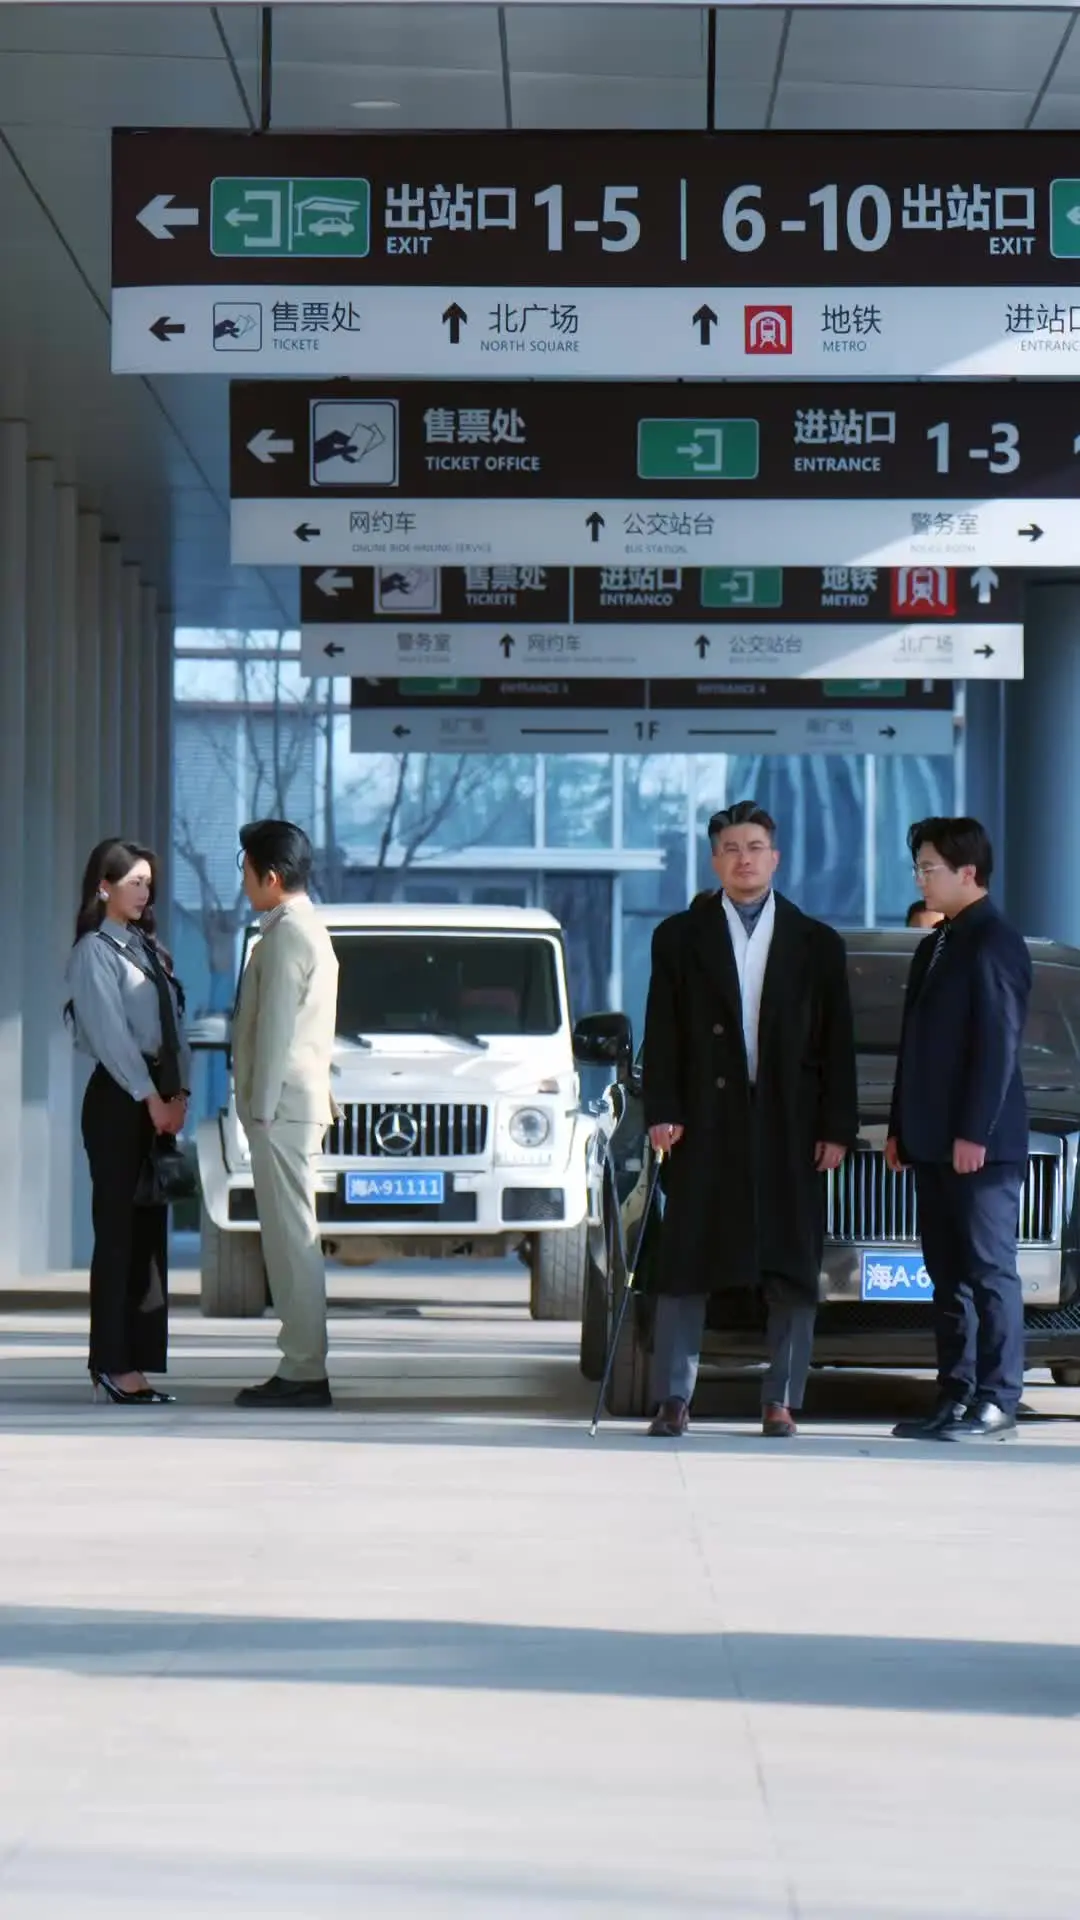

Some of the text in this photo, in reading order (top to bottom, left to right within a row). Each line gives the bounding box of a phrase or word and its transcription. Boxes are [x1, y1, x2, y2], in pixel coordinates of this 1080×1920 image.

[385, 183, 641, 253] 出站口 1-5
[722, 183, 1035, 253] 6-10 出站口
[386, 236, 433, 254] EXIT
[989, 236, 1035, 255] EXIT
[271, 301, 361, 333] 售票处
[489, 303, 578, 334] 北广场
[821, 304, 881, 335] 地铁
[273, 338, 319, 351] TICKETE
[480, 340, 579, 353] NORTH SQUARE
[822, 340, 867, 353] METRO
[423, 407, 526, 444] 售票处
[794, 408, 1021, 474] 进站口 1-3
[425, 456, 540, 471] TICKET OFFICE
[794, 457, 881, 472] ENTRANCE
[349, 511, 416, 534] 网约车
[623, 511, 715, 536] 公交站台
[464, 566, 546, 591] 售票处
[600, 566, 682, 591] 进站口
[822, 566, 877, 591] 地铁
[821, 594, 869, 606] METRO
[635, 720, 659, 741] 1F
